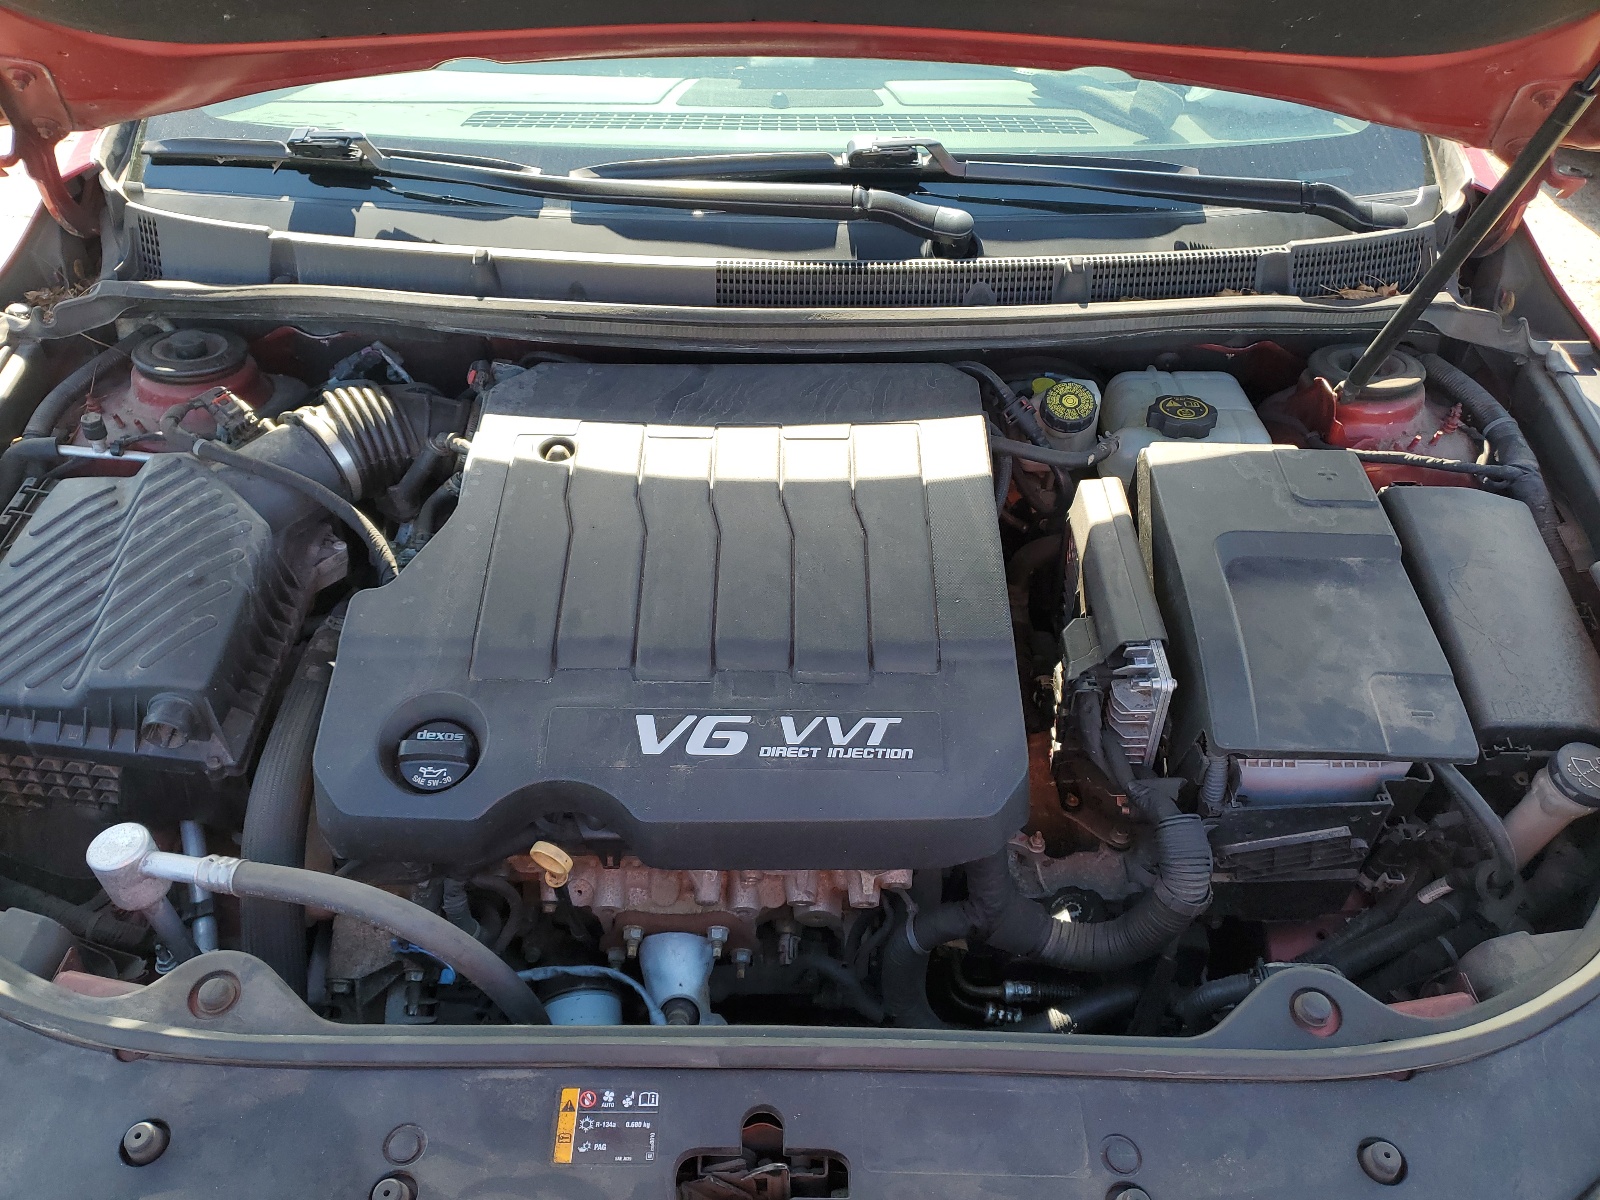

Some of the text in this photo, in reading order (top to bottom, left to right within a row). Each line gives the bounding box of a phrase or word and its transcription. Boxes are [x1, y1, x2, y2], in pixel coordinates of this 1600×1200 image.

[416, 729, 466, 741] dexos
[635, 714, 903, 756] V6 VVT
[758, 746, 914, 760] DIRECT INJECTION
[411, 774, 452, 787] SAE 5W-30
[593, 1143, 607, 1151] PAG
